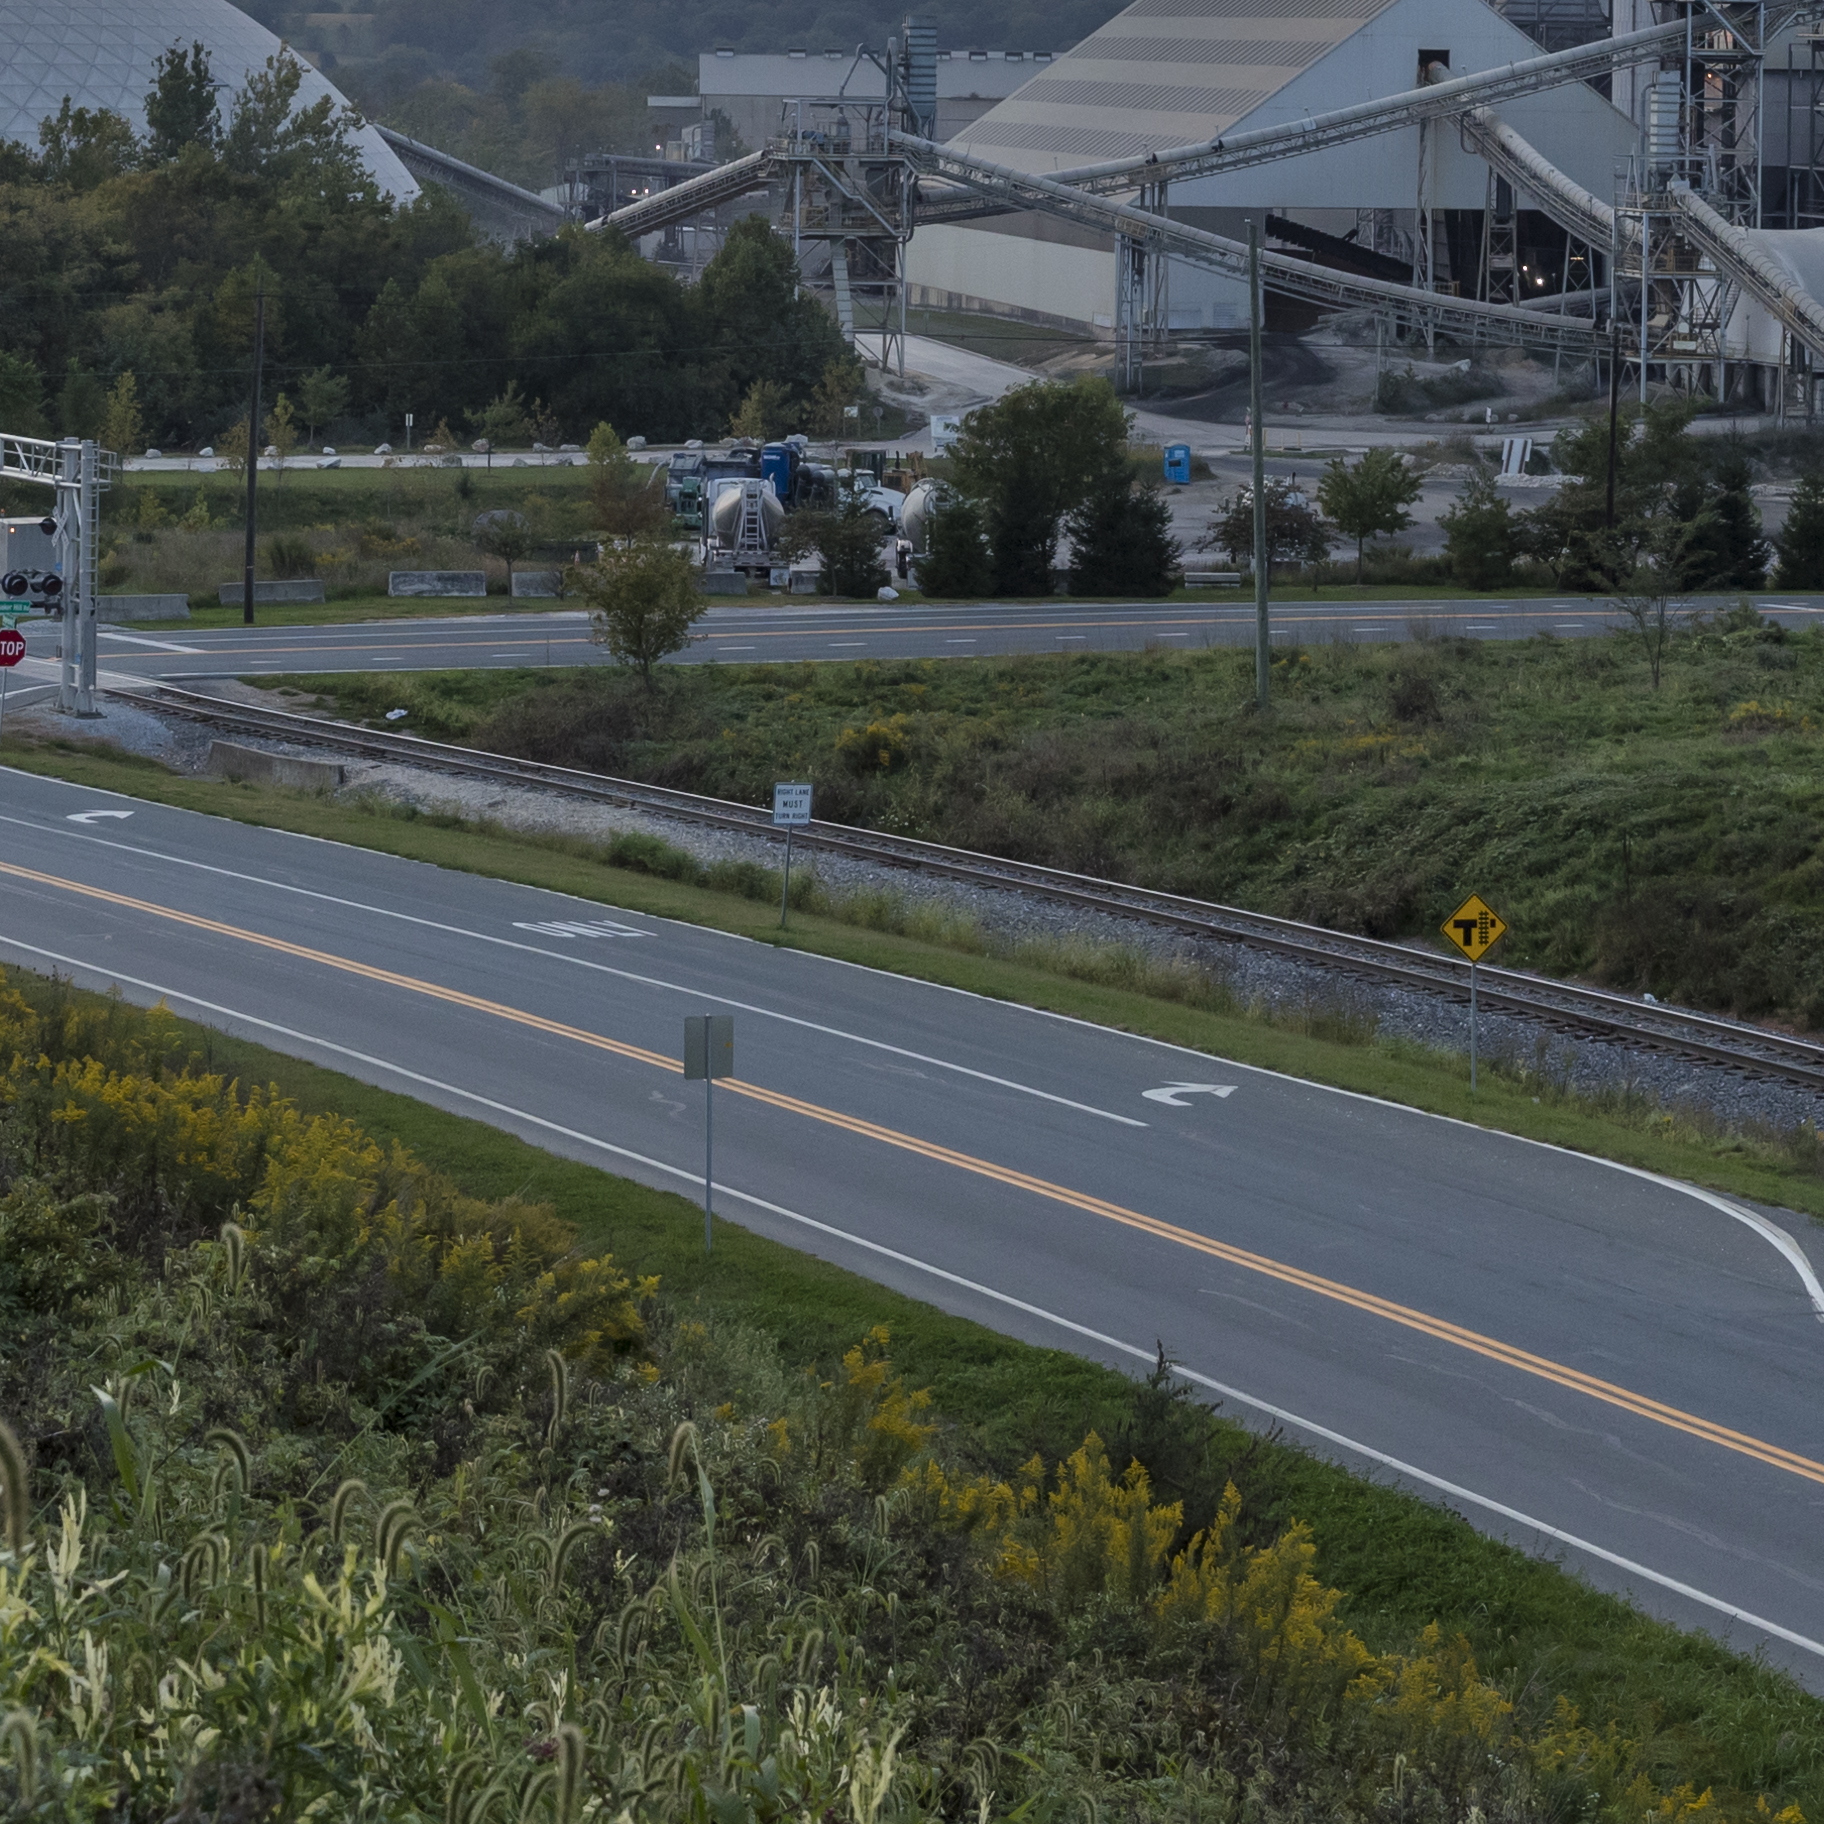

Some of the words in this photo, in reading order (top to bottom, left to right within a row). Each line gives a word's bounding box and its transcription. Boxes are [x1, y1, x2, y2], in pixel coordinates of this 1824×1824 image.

[777, 788, 794, 796] RIGHT
[795, 788, 810, 796] LANE
[782, 799, 803, 809] MUST
[775, 812, 790, 820] TURN
[791, 812, 808, 820] RIGHT
[512, 920, 659, 938] ONLY
